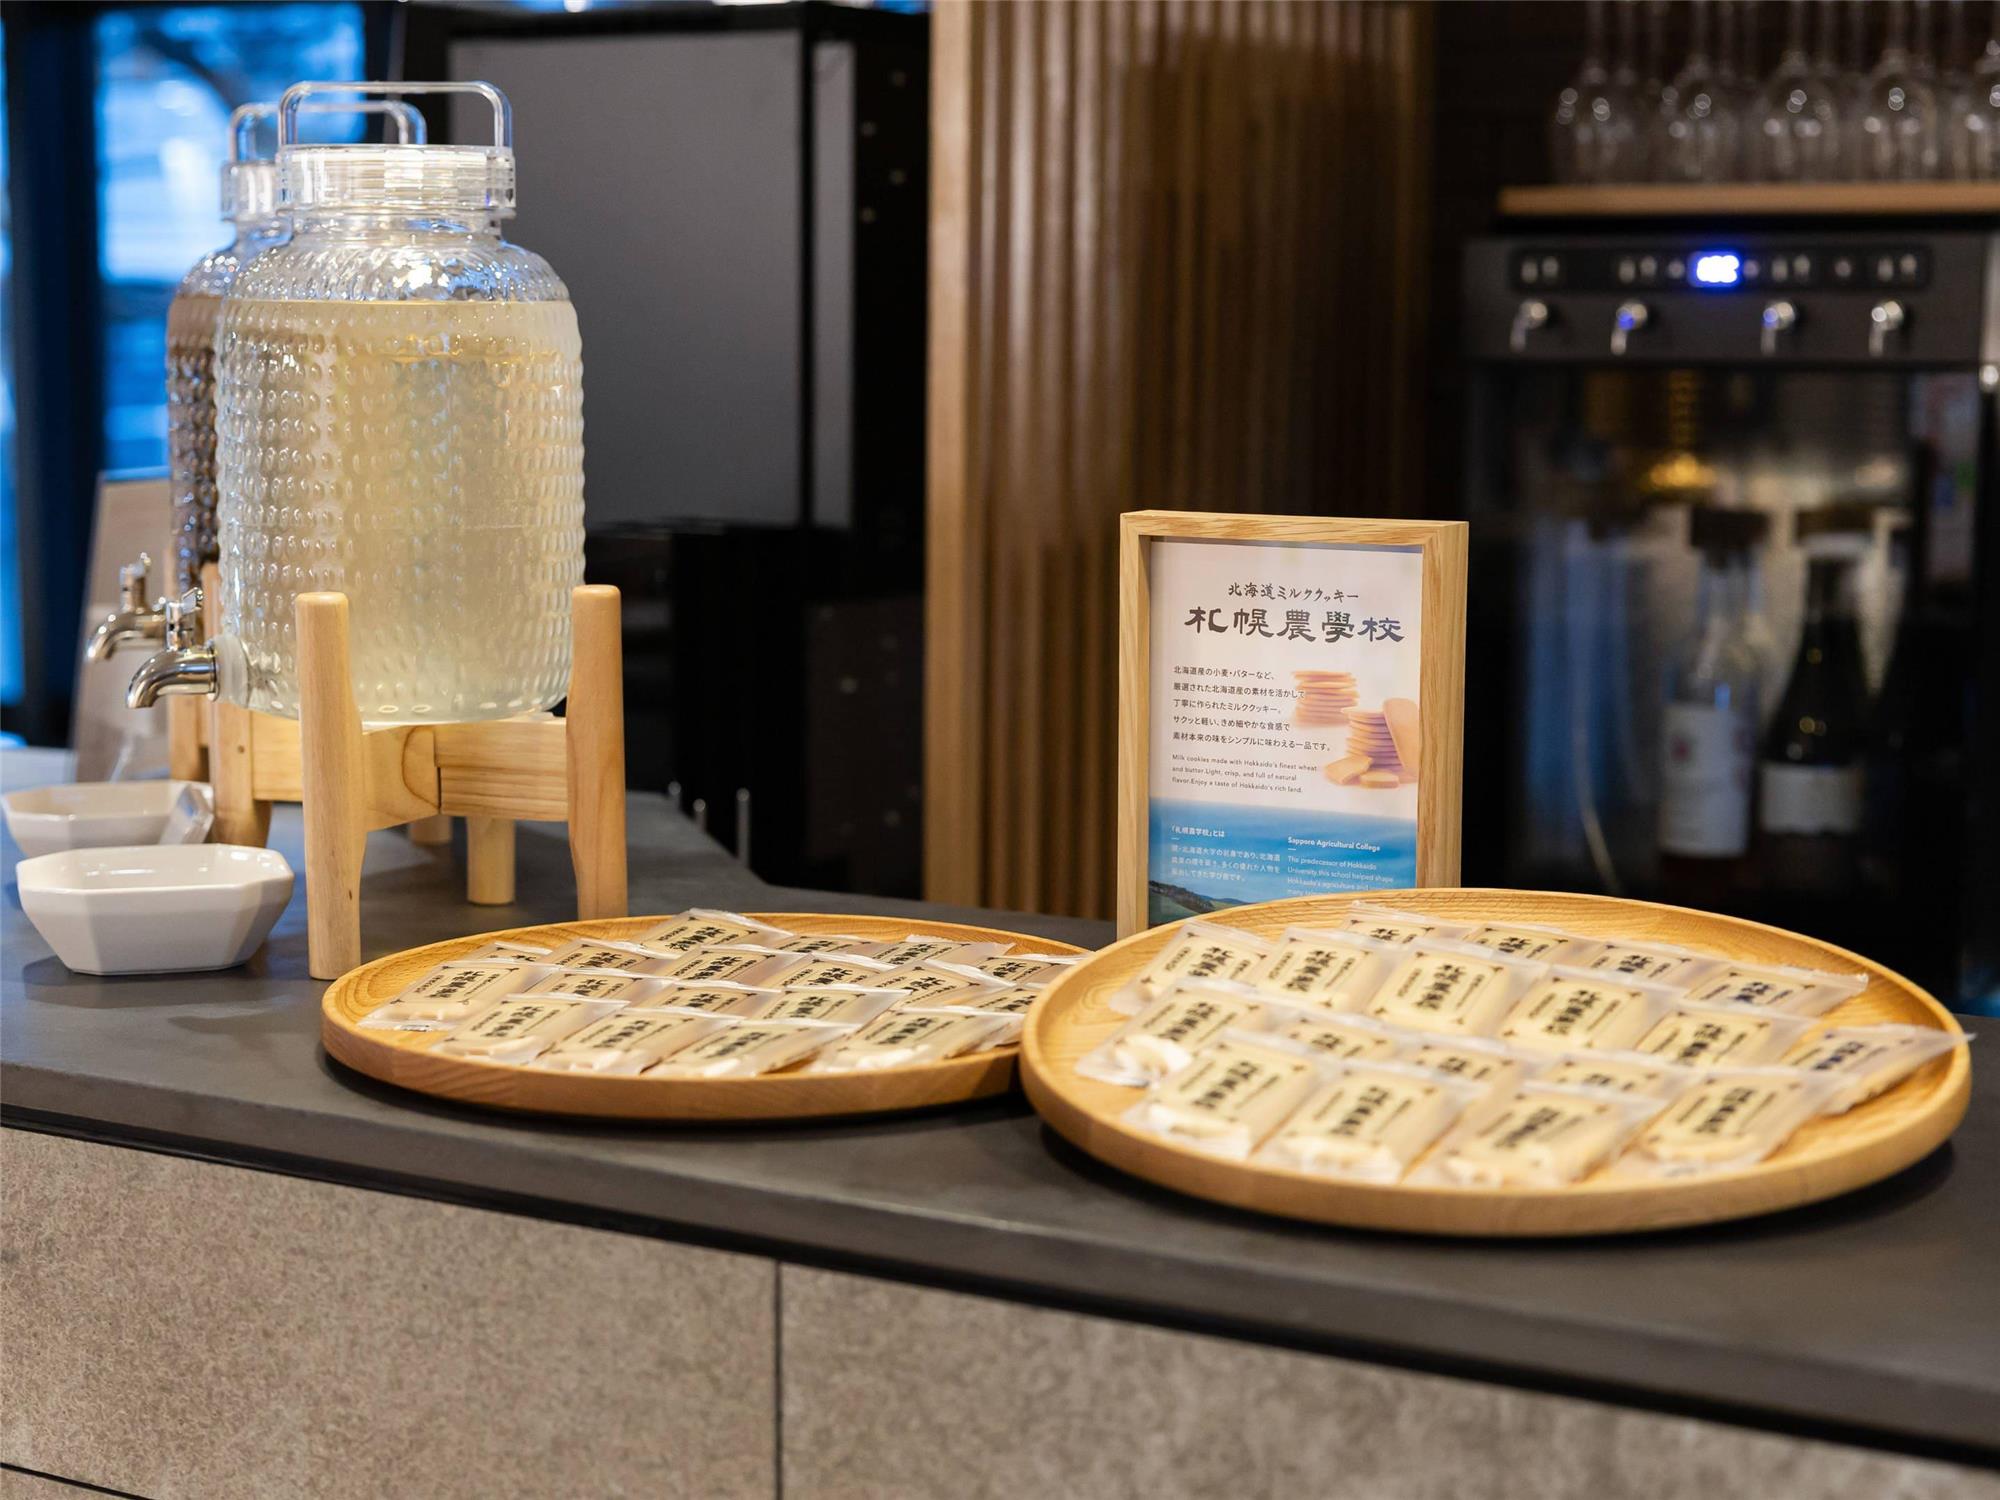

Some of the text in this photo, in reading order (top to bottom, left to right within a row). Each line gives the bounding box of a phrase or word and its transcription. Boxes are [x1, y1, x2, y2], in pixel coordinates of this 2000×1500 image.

[1227, 582, 1359, 603] 北海道ミルククッキー
[1184, 606, 1405, 643] 札幌農學校
[1187, 755, 1210, 763] cookies
[1279, 762, 1296, 770] finest
[1288, 836, 1380, 852] Sapporo Agricultural College
